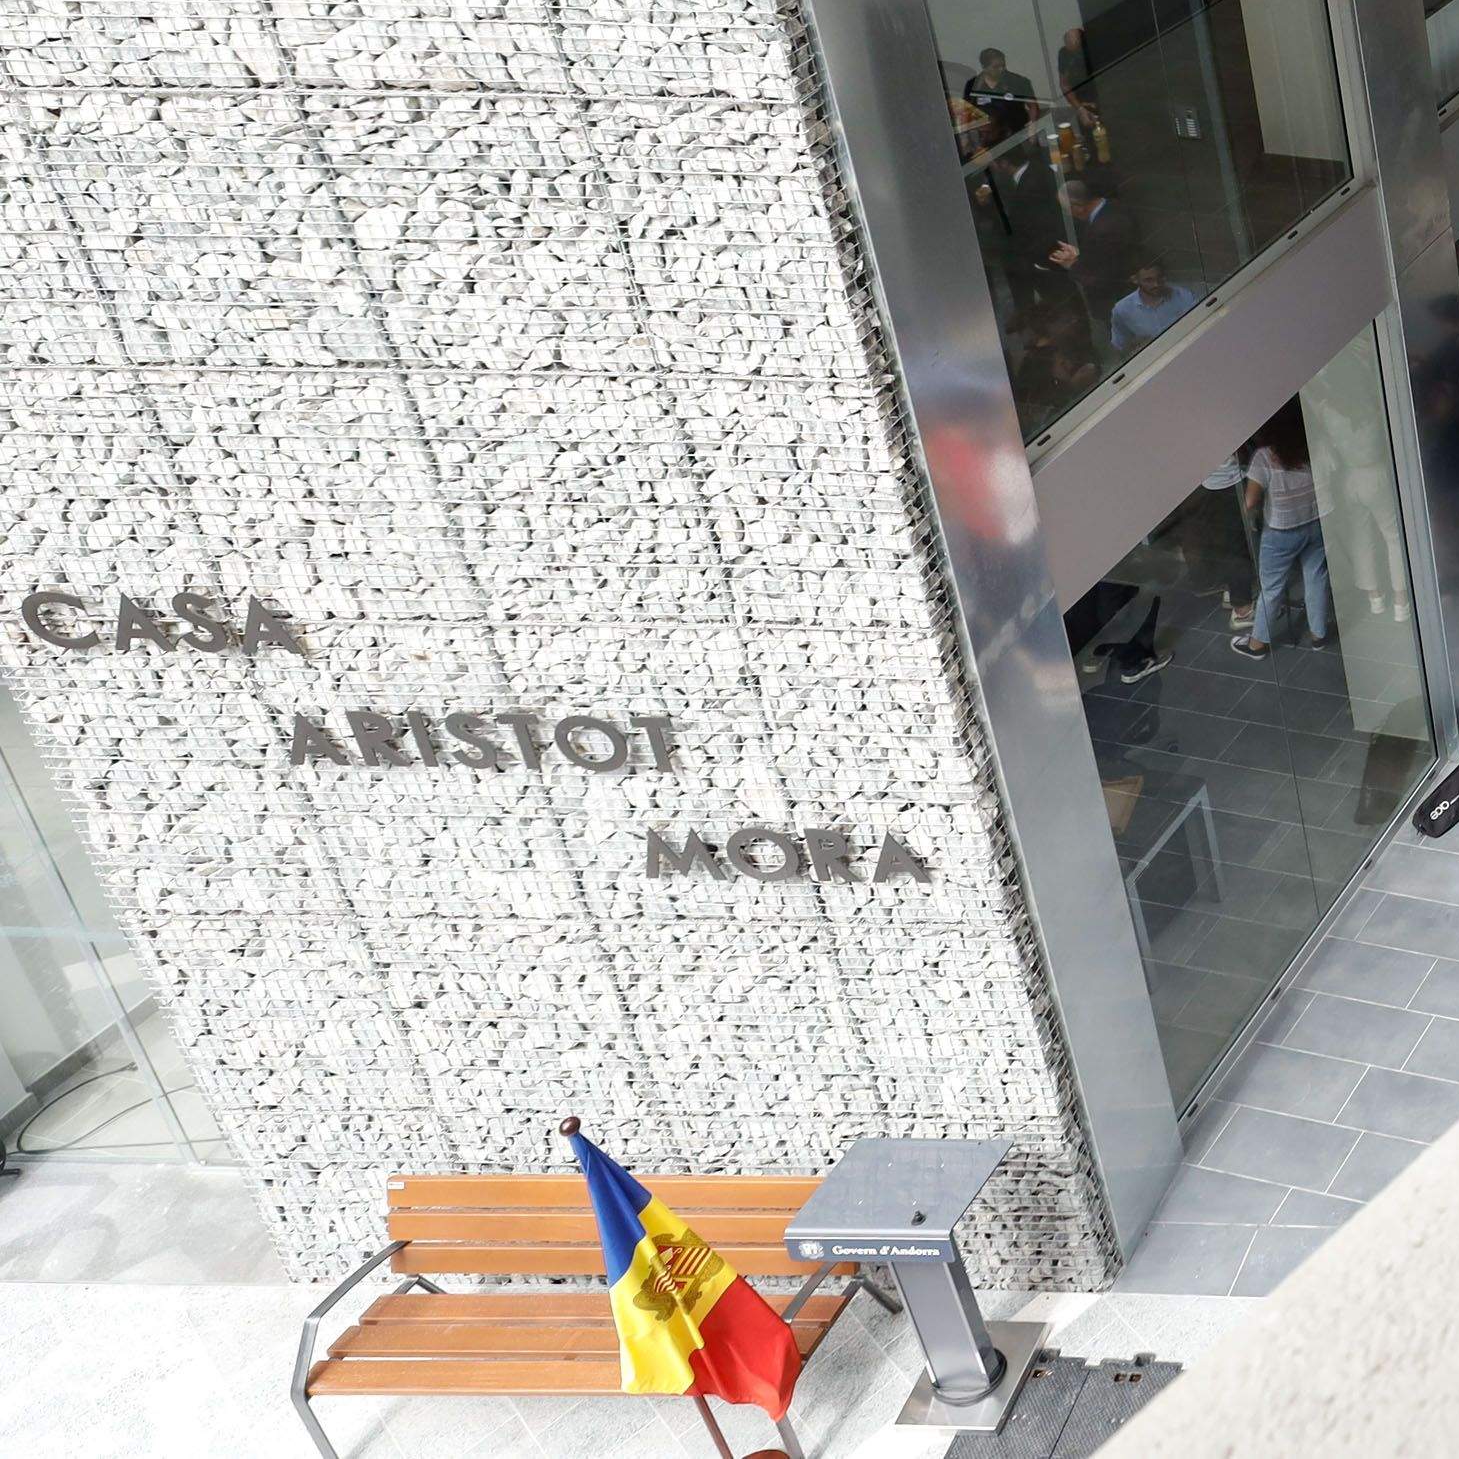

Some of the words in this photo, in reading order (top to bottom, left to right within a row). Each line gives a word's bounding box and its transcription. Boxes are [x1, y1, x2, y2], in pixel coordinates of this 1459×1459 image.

[21, 591, 303, 655] CASA
[290, 710, 677, 773] ARISTOT
[645, 826, 933, 883] MORA
[831, 1245, 877, 1256] Govern
[879, 1245, 940, 1256] d'Andorra
